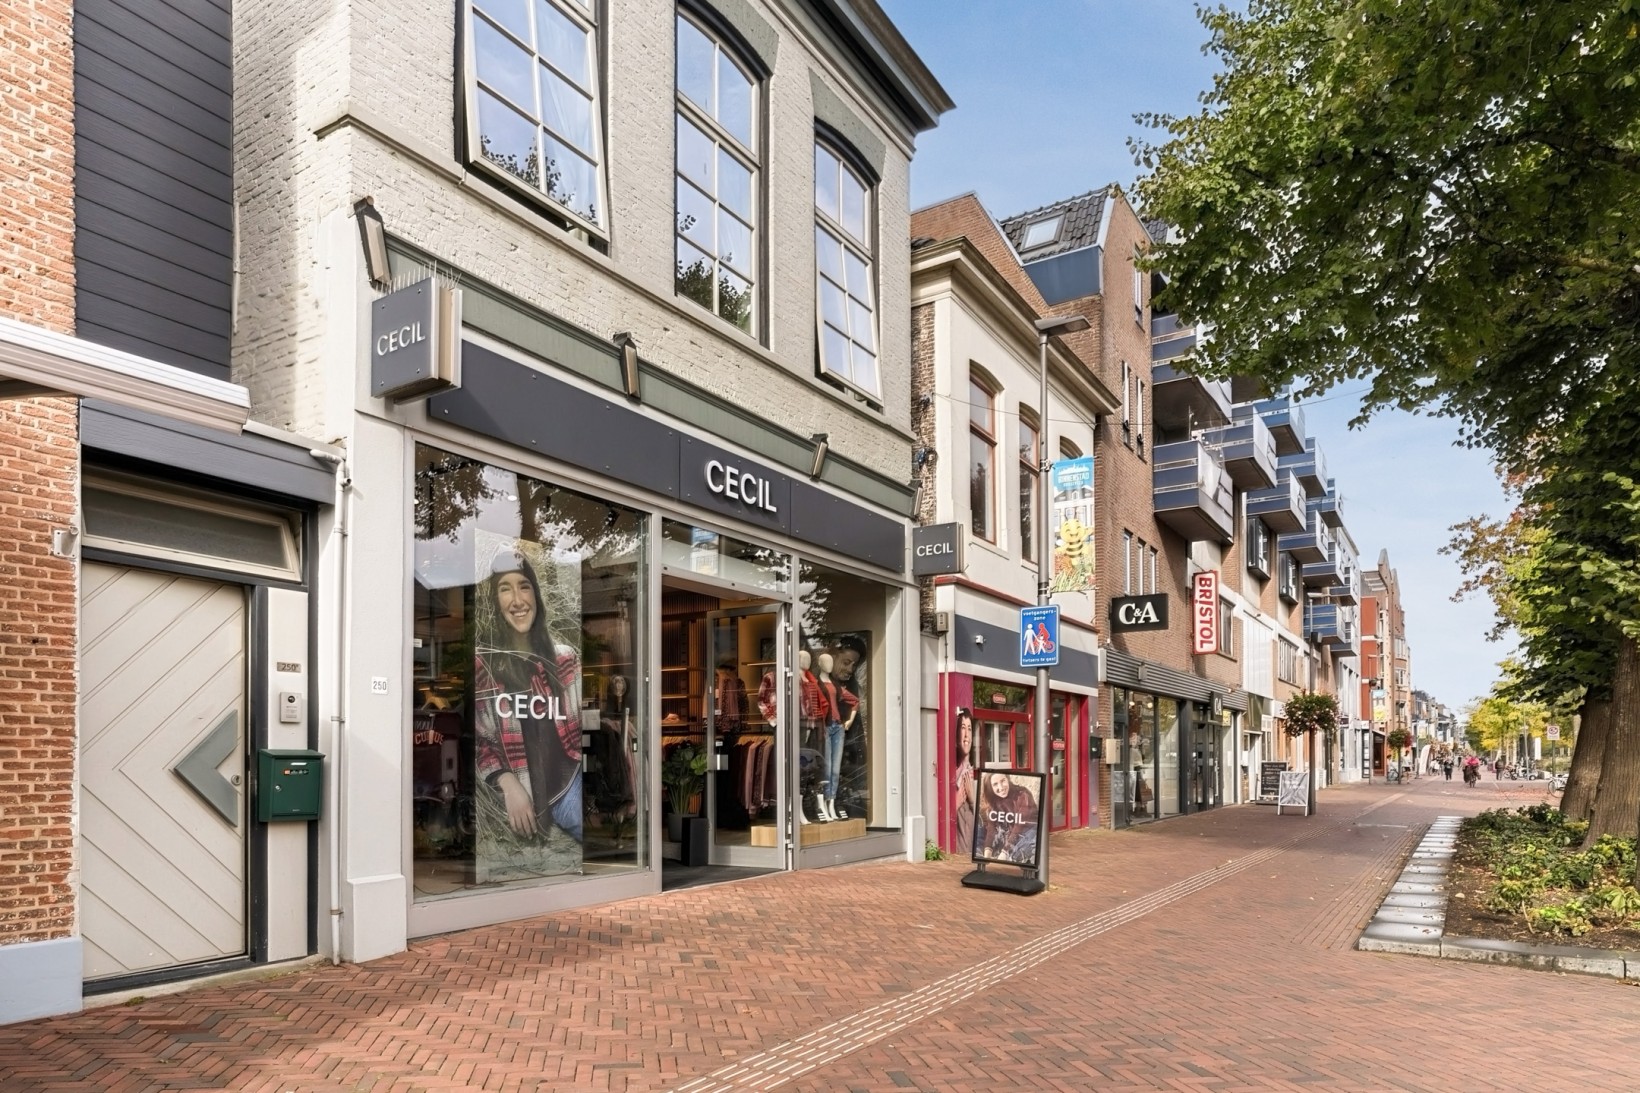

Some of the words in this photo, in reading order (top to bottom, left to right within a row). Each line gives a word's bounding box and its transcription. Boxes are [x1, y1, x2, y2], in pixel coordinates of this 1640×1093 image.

[377, 321, 425, 355] CECIL
[704, 460, 777, 512] CECIL
[917, 542, 953, 556] CECIL
[1118, 601, 1159, 625] C&A
[1197, 577, 1214, 649] BRISTOL
[373, 681, 387, 691] 250
[495, 693, 567, 720] CECIL
[989, 810, 1026, 825] CECIL
